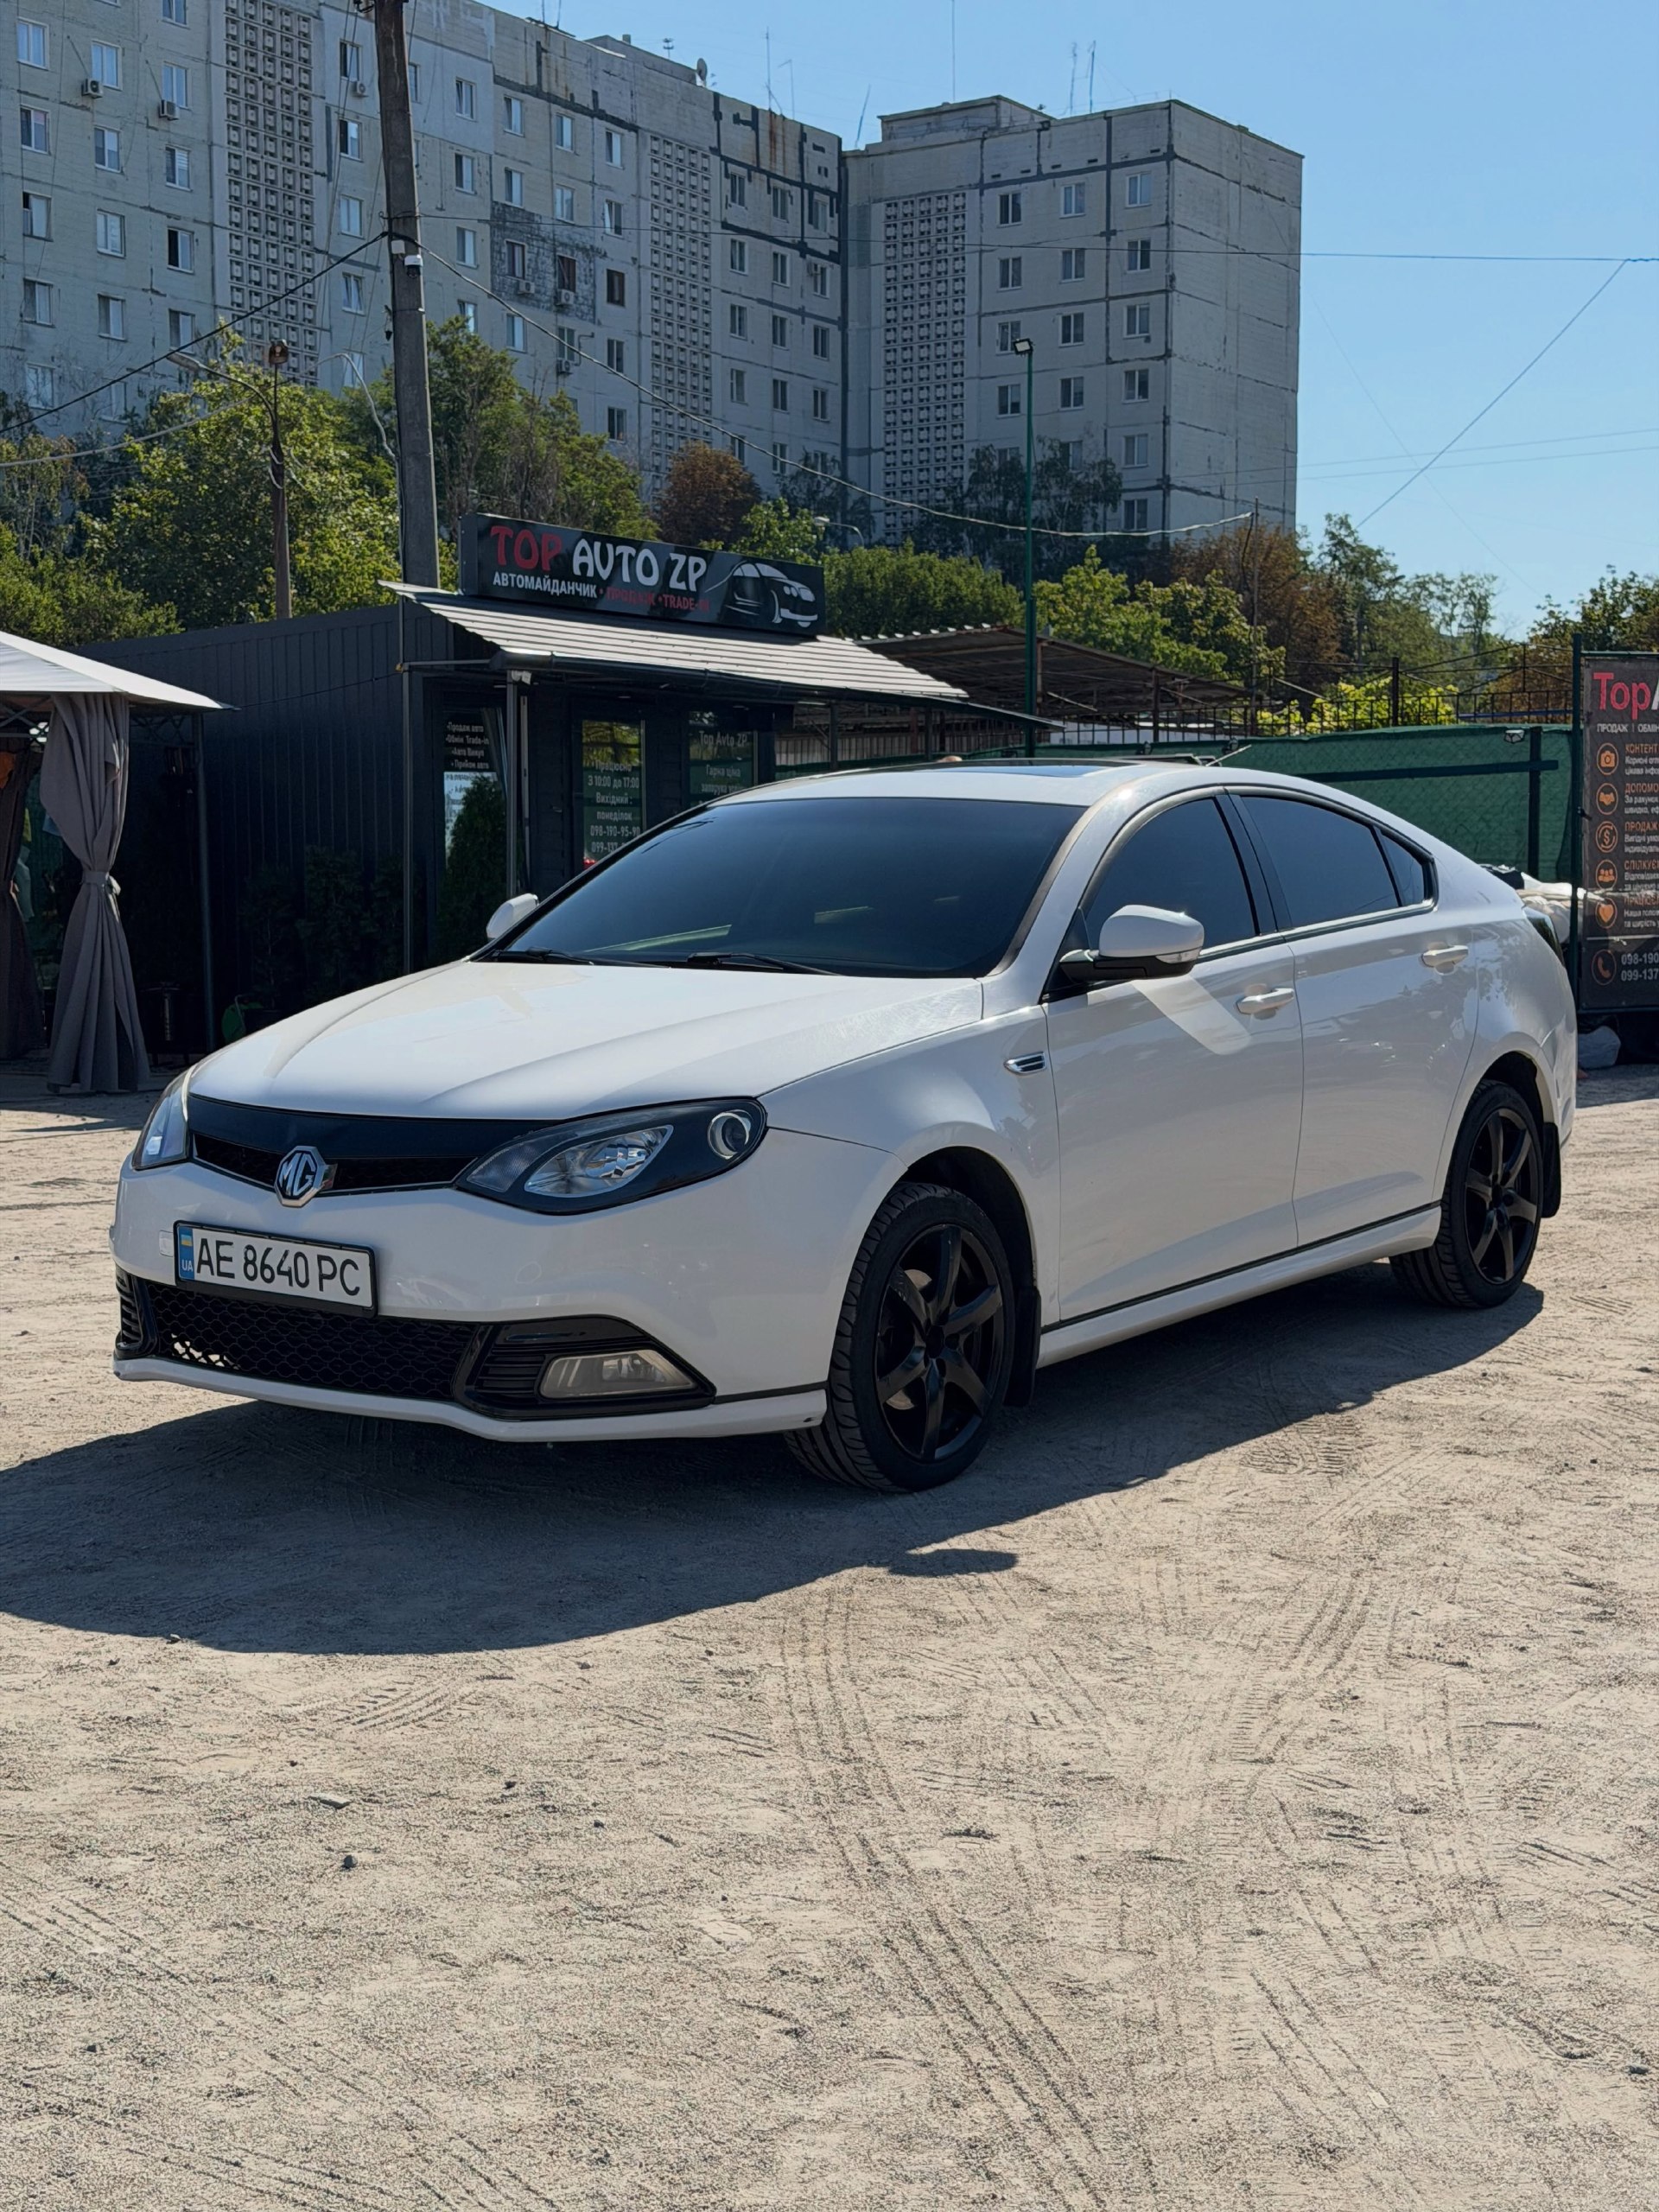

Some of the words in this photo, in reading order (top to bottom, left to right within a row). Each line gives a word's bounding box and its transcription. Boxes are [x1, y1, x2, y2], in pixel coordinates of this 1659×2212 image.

[490, 525, 562, 571] TOP
[572, 538, 659, 586] AVTO
[669, 553, 707, 592] ZP
[493, 571, 598, 598] АВТОМАЙДАНЧИК
[1597, 723, 1629, 733] ПРОДАЖ
[698, 730, 715, 746] Top
[737, 733, 748, 747] ZP
[1625, 743, 1658, 754] КОНТЕНТ
[594, 775, 612, 787] 10:00
[613, 778, 622, 789] до
[623, 776, 640, 789] 17:00
[1624, 821, 1658, 833] ПРОДАЖ
[278, 1151, 317, 1197] MG
[181, 1259, 194, 1272] UA
[196, 1237, 236, 1280] AE
[243, 1244, 310, 1288] 8640
[316, 1254, 360, 1296] PC
